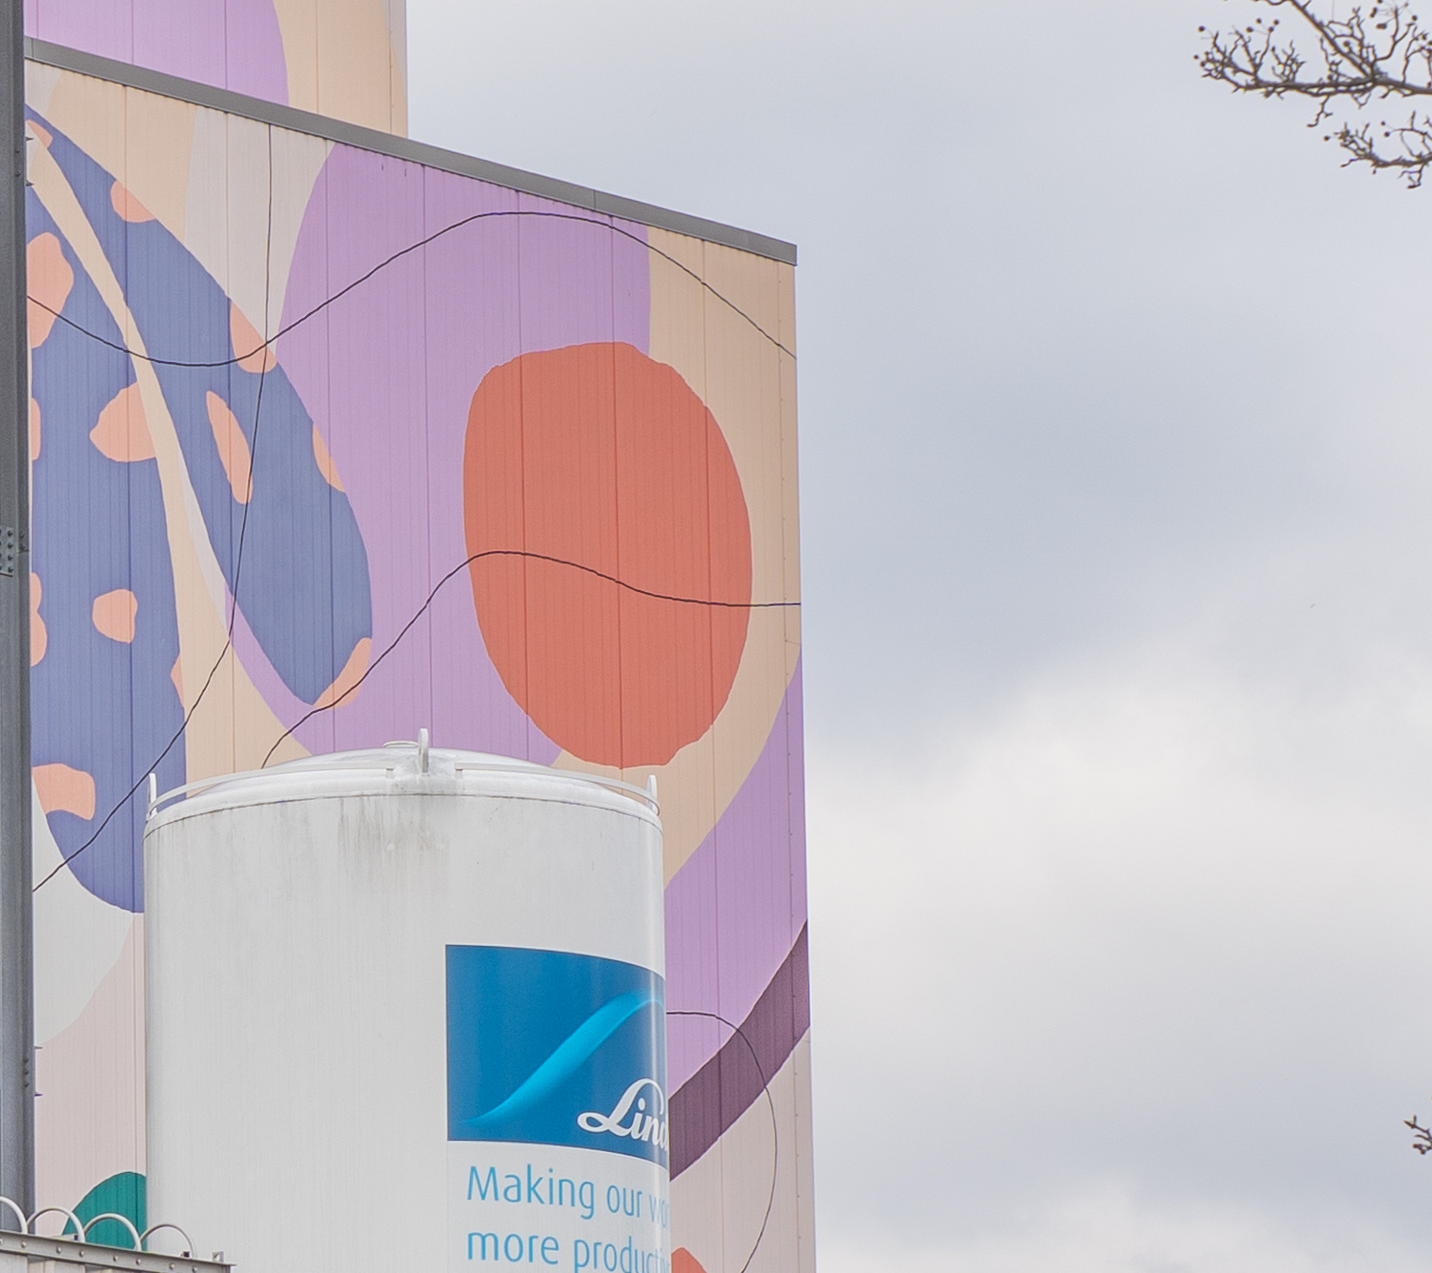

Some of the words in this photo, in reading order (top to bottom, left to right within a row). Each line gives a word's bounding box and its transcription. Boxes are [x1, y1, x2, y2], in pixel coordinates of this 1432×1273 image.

[467, 1164, 595, 1220] Making
[606, 1185, 643, 1218] our
[467, 1231, 559, 1265] more
